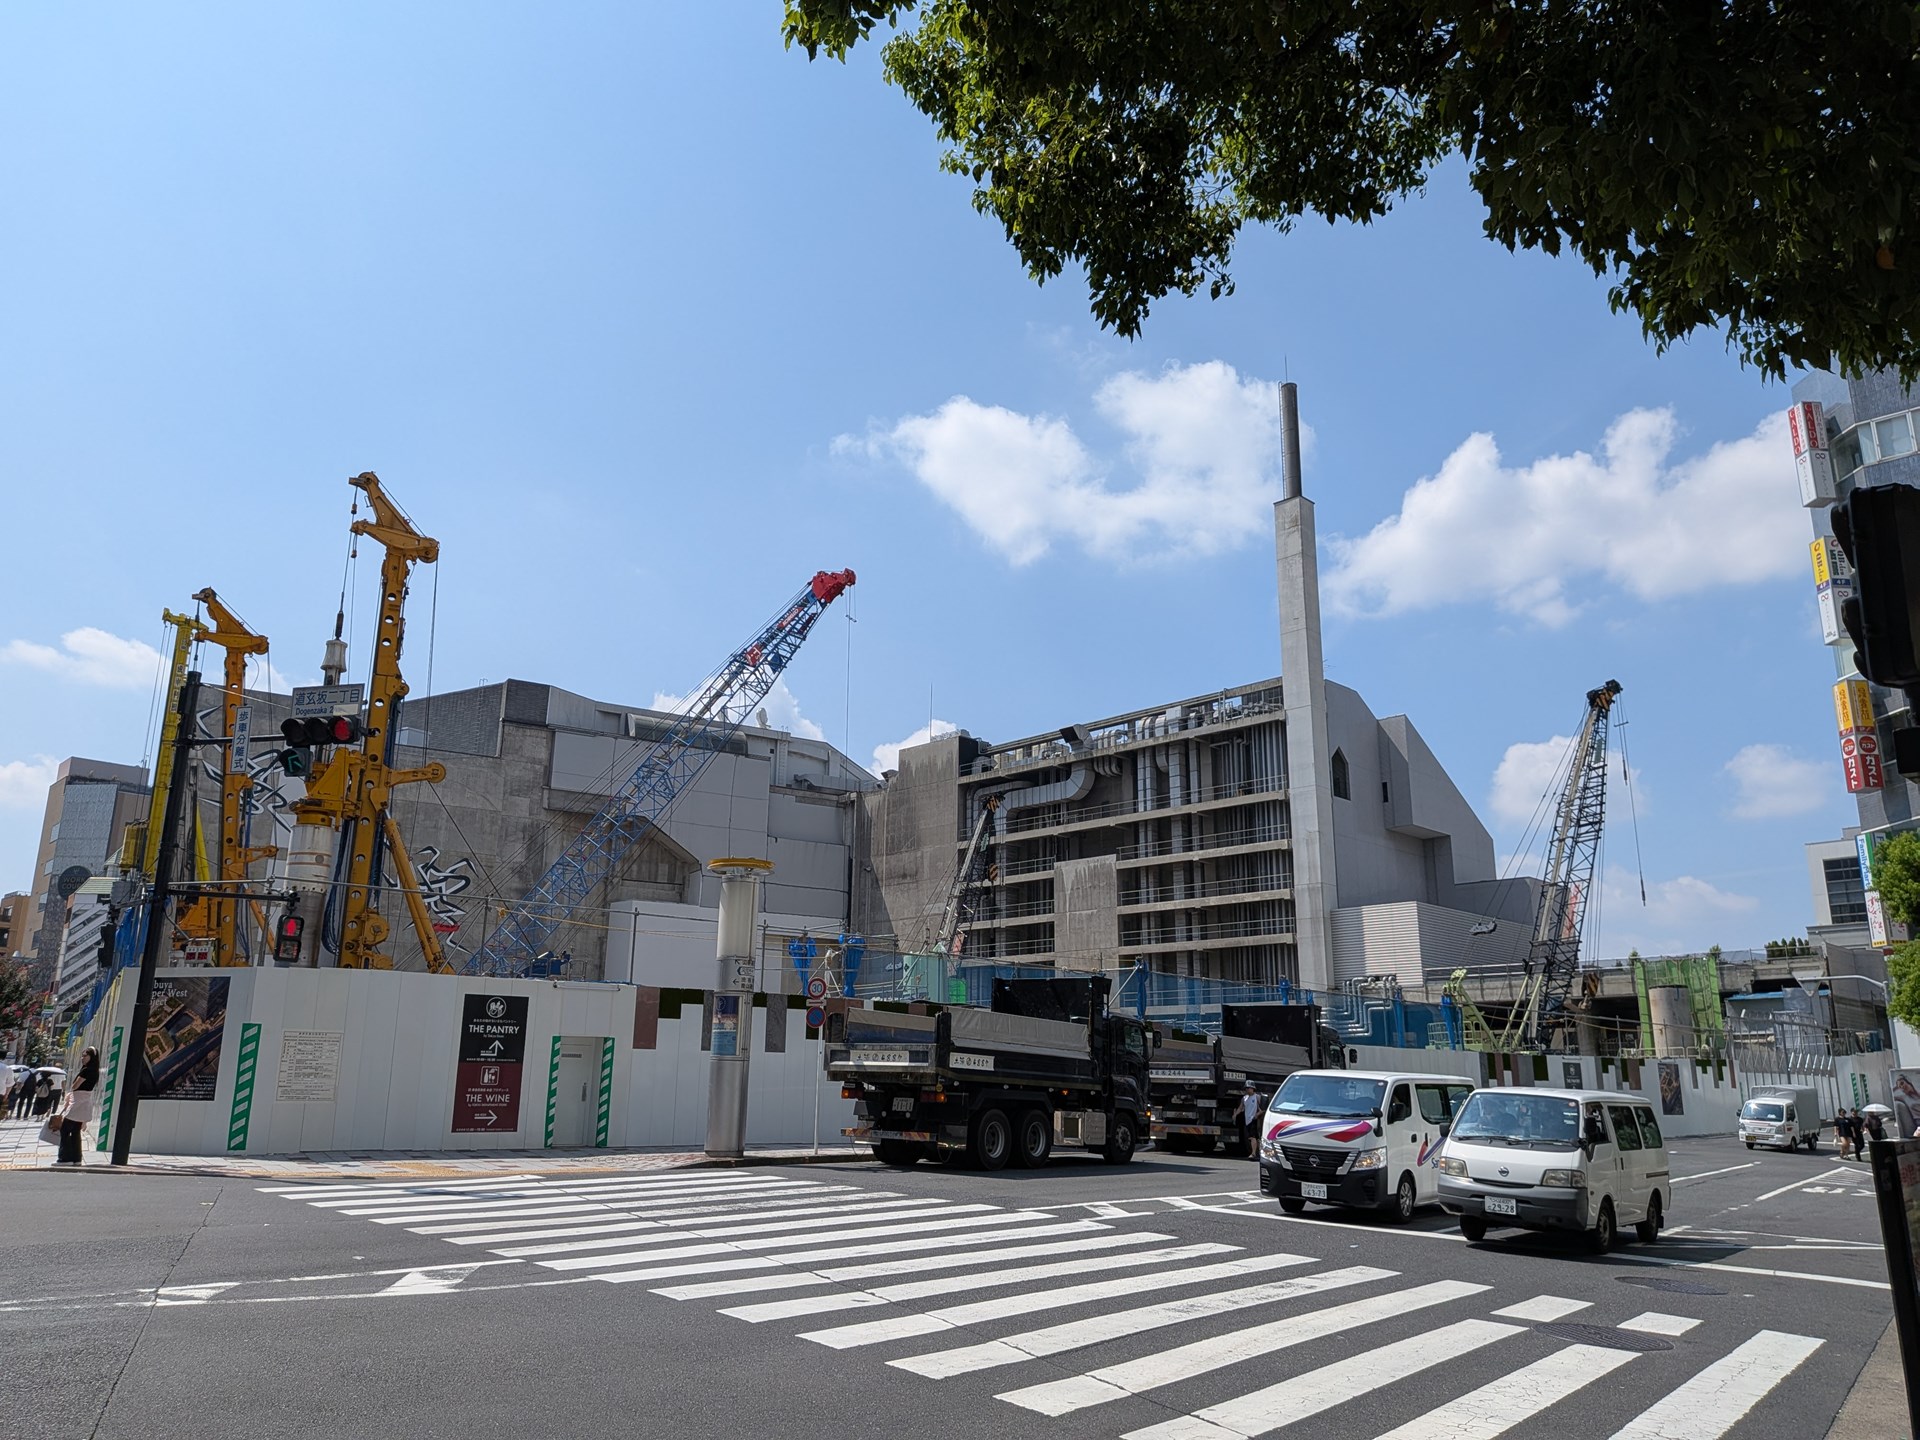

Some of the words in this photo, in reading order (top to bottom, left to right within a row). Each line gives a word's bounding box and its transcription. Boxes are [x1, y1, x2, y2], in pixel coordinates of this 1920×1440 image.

[1804, 403, 1818, 448] CALDO
[1788, 409, 1801, 456] CALDO
[294, 688, 361, 706] 道玄坂二丁目
[295, 706, 328, 717] Dogenzaka
[233, 711, 249, 769] 歩車分離式
[1847, 756, 1858, 789] ガスト
[1865, 755, 1878, 787] ガスト
[1858, 838, 1872, 888] FamilyMart
[153, 980, 173, 991] buya
[811, 983, 823, 993] 30
[151, 989, 166, 999] per
[168, 988, 188, 998] West
[149, 998, 168, 1007] ject
[468, 1024, 485, 1034] THE
[486, 1025, 520, 1034] PANTRY
[466, 1094, 482, 1103] THE
[485, 1094, 510, 1103] WINE
[1492, 1203, 1515, 1214] 29-28
